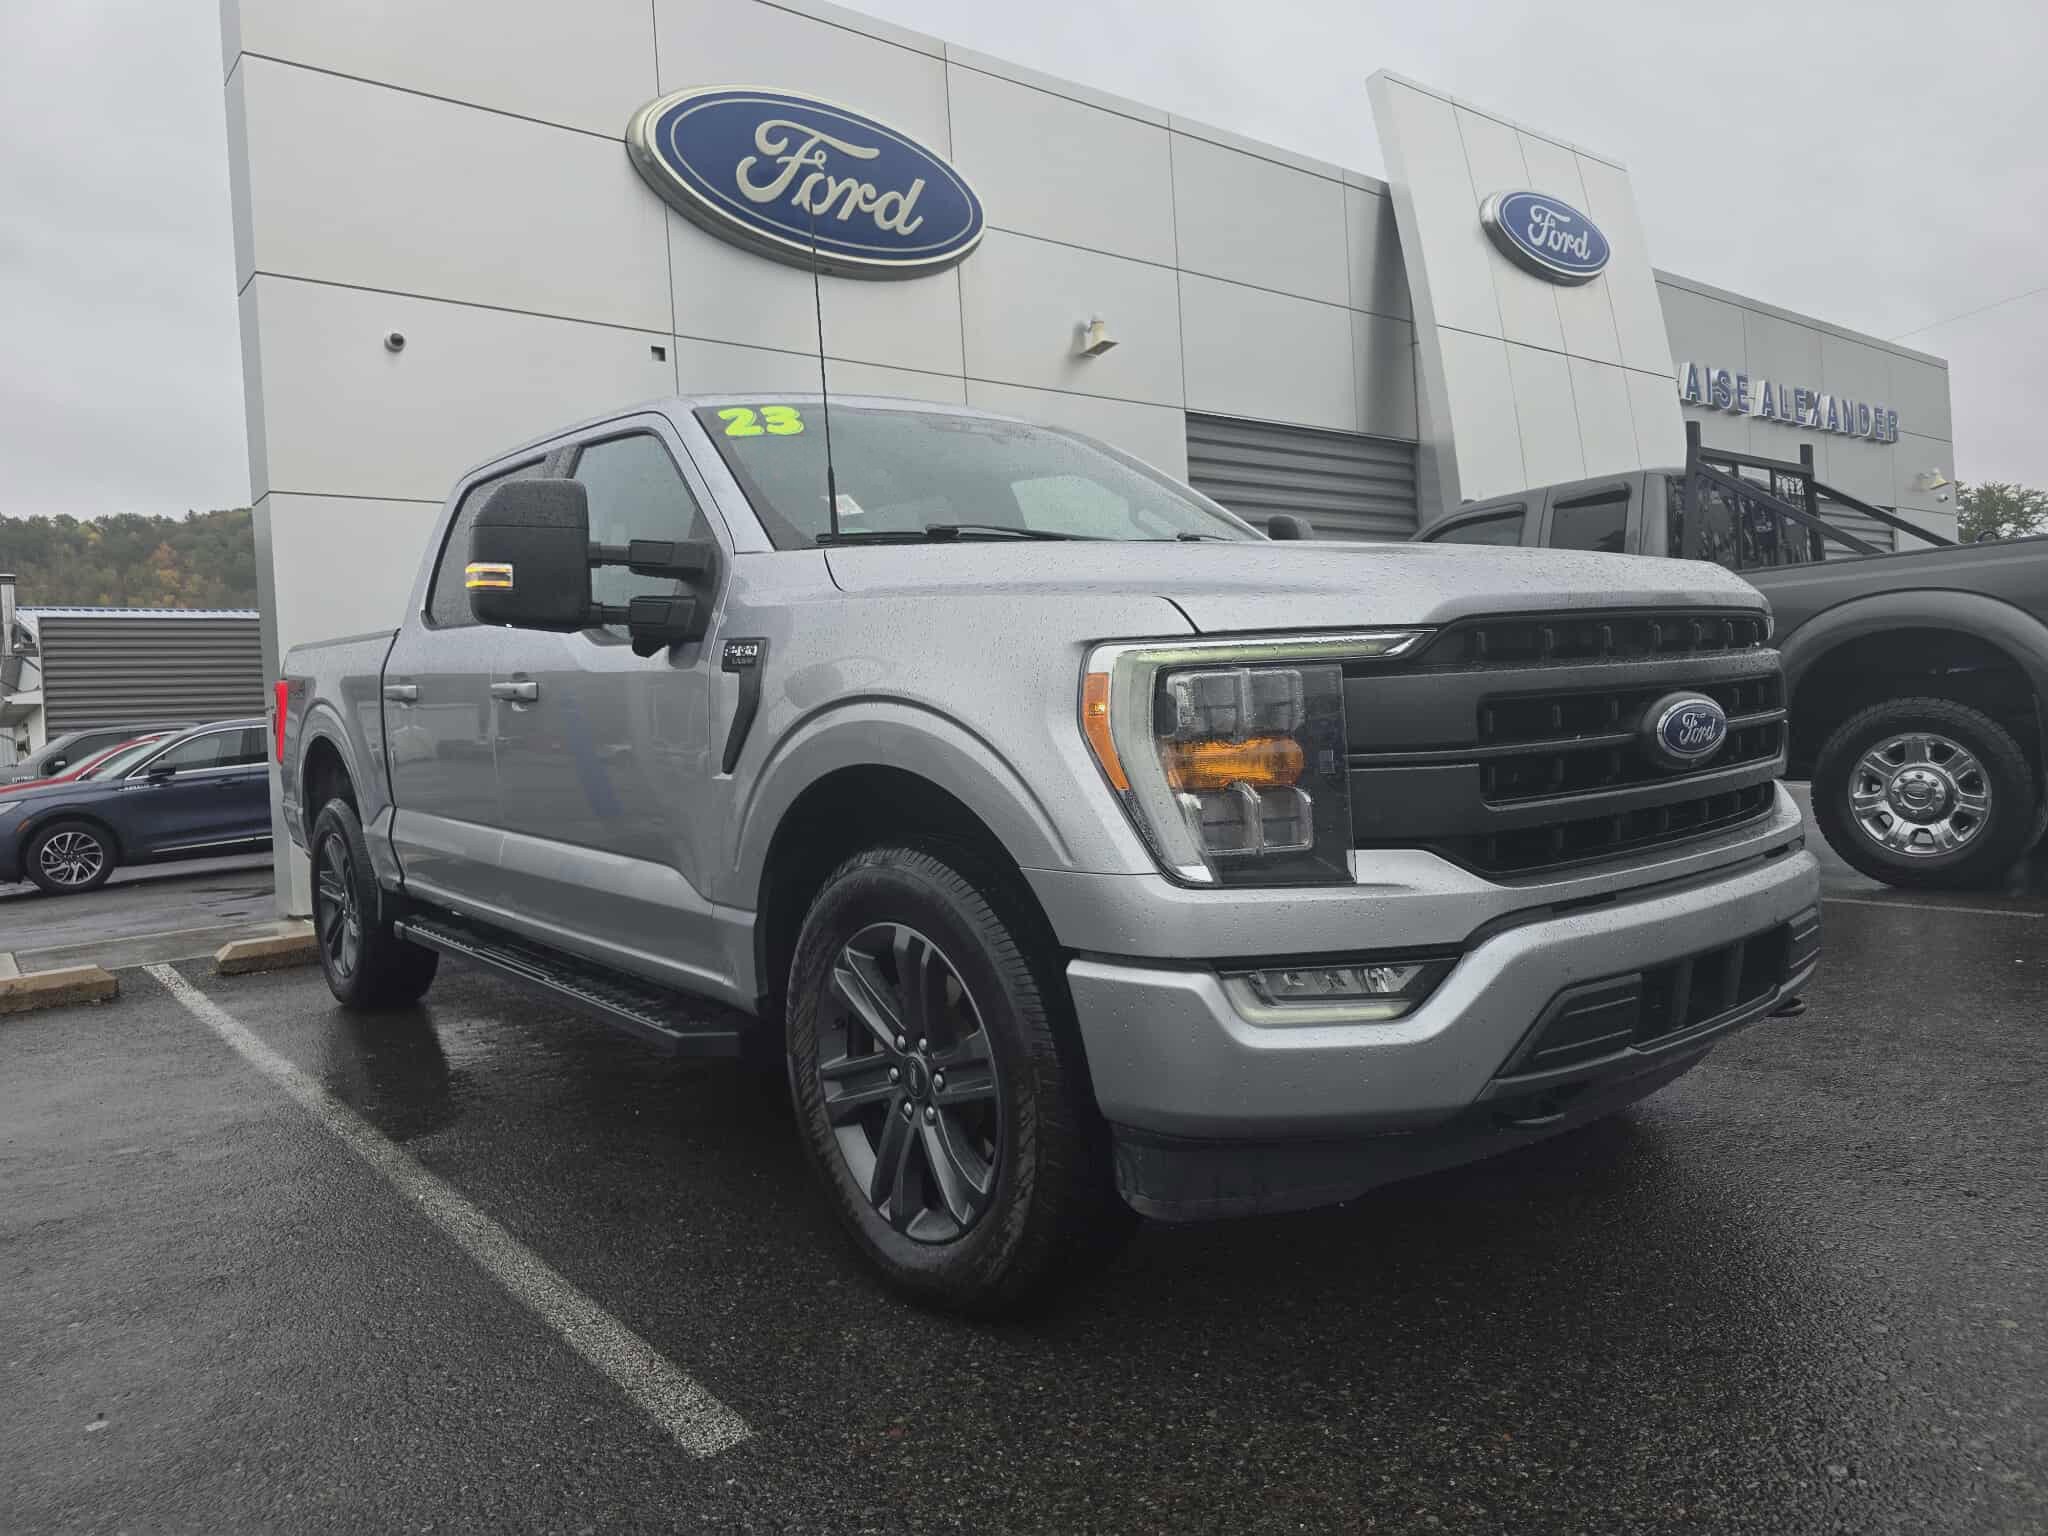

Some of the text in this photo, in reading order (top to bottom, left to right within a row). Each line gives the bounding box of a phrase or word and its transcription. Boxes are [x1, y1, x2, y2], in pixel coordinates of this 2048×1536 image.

[736, 119, 925, 236] Ford
[1528, 204, 1591, 260] Ford
[717, 405, 805, 437] 23
[1680, 361, 1899, 443] AISE ALEXANDER
[1680, 712, 1716, 745] Ford
